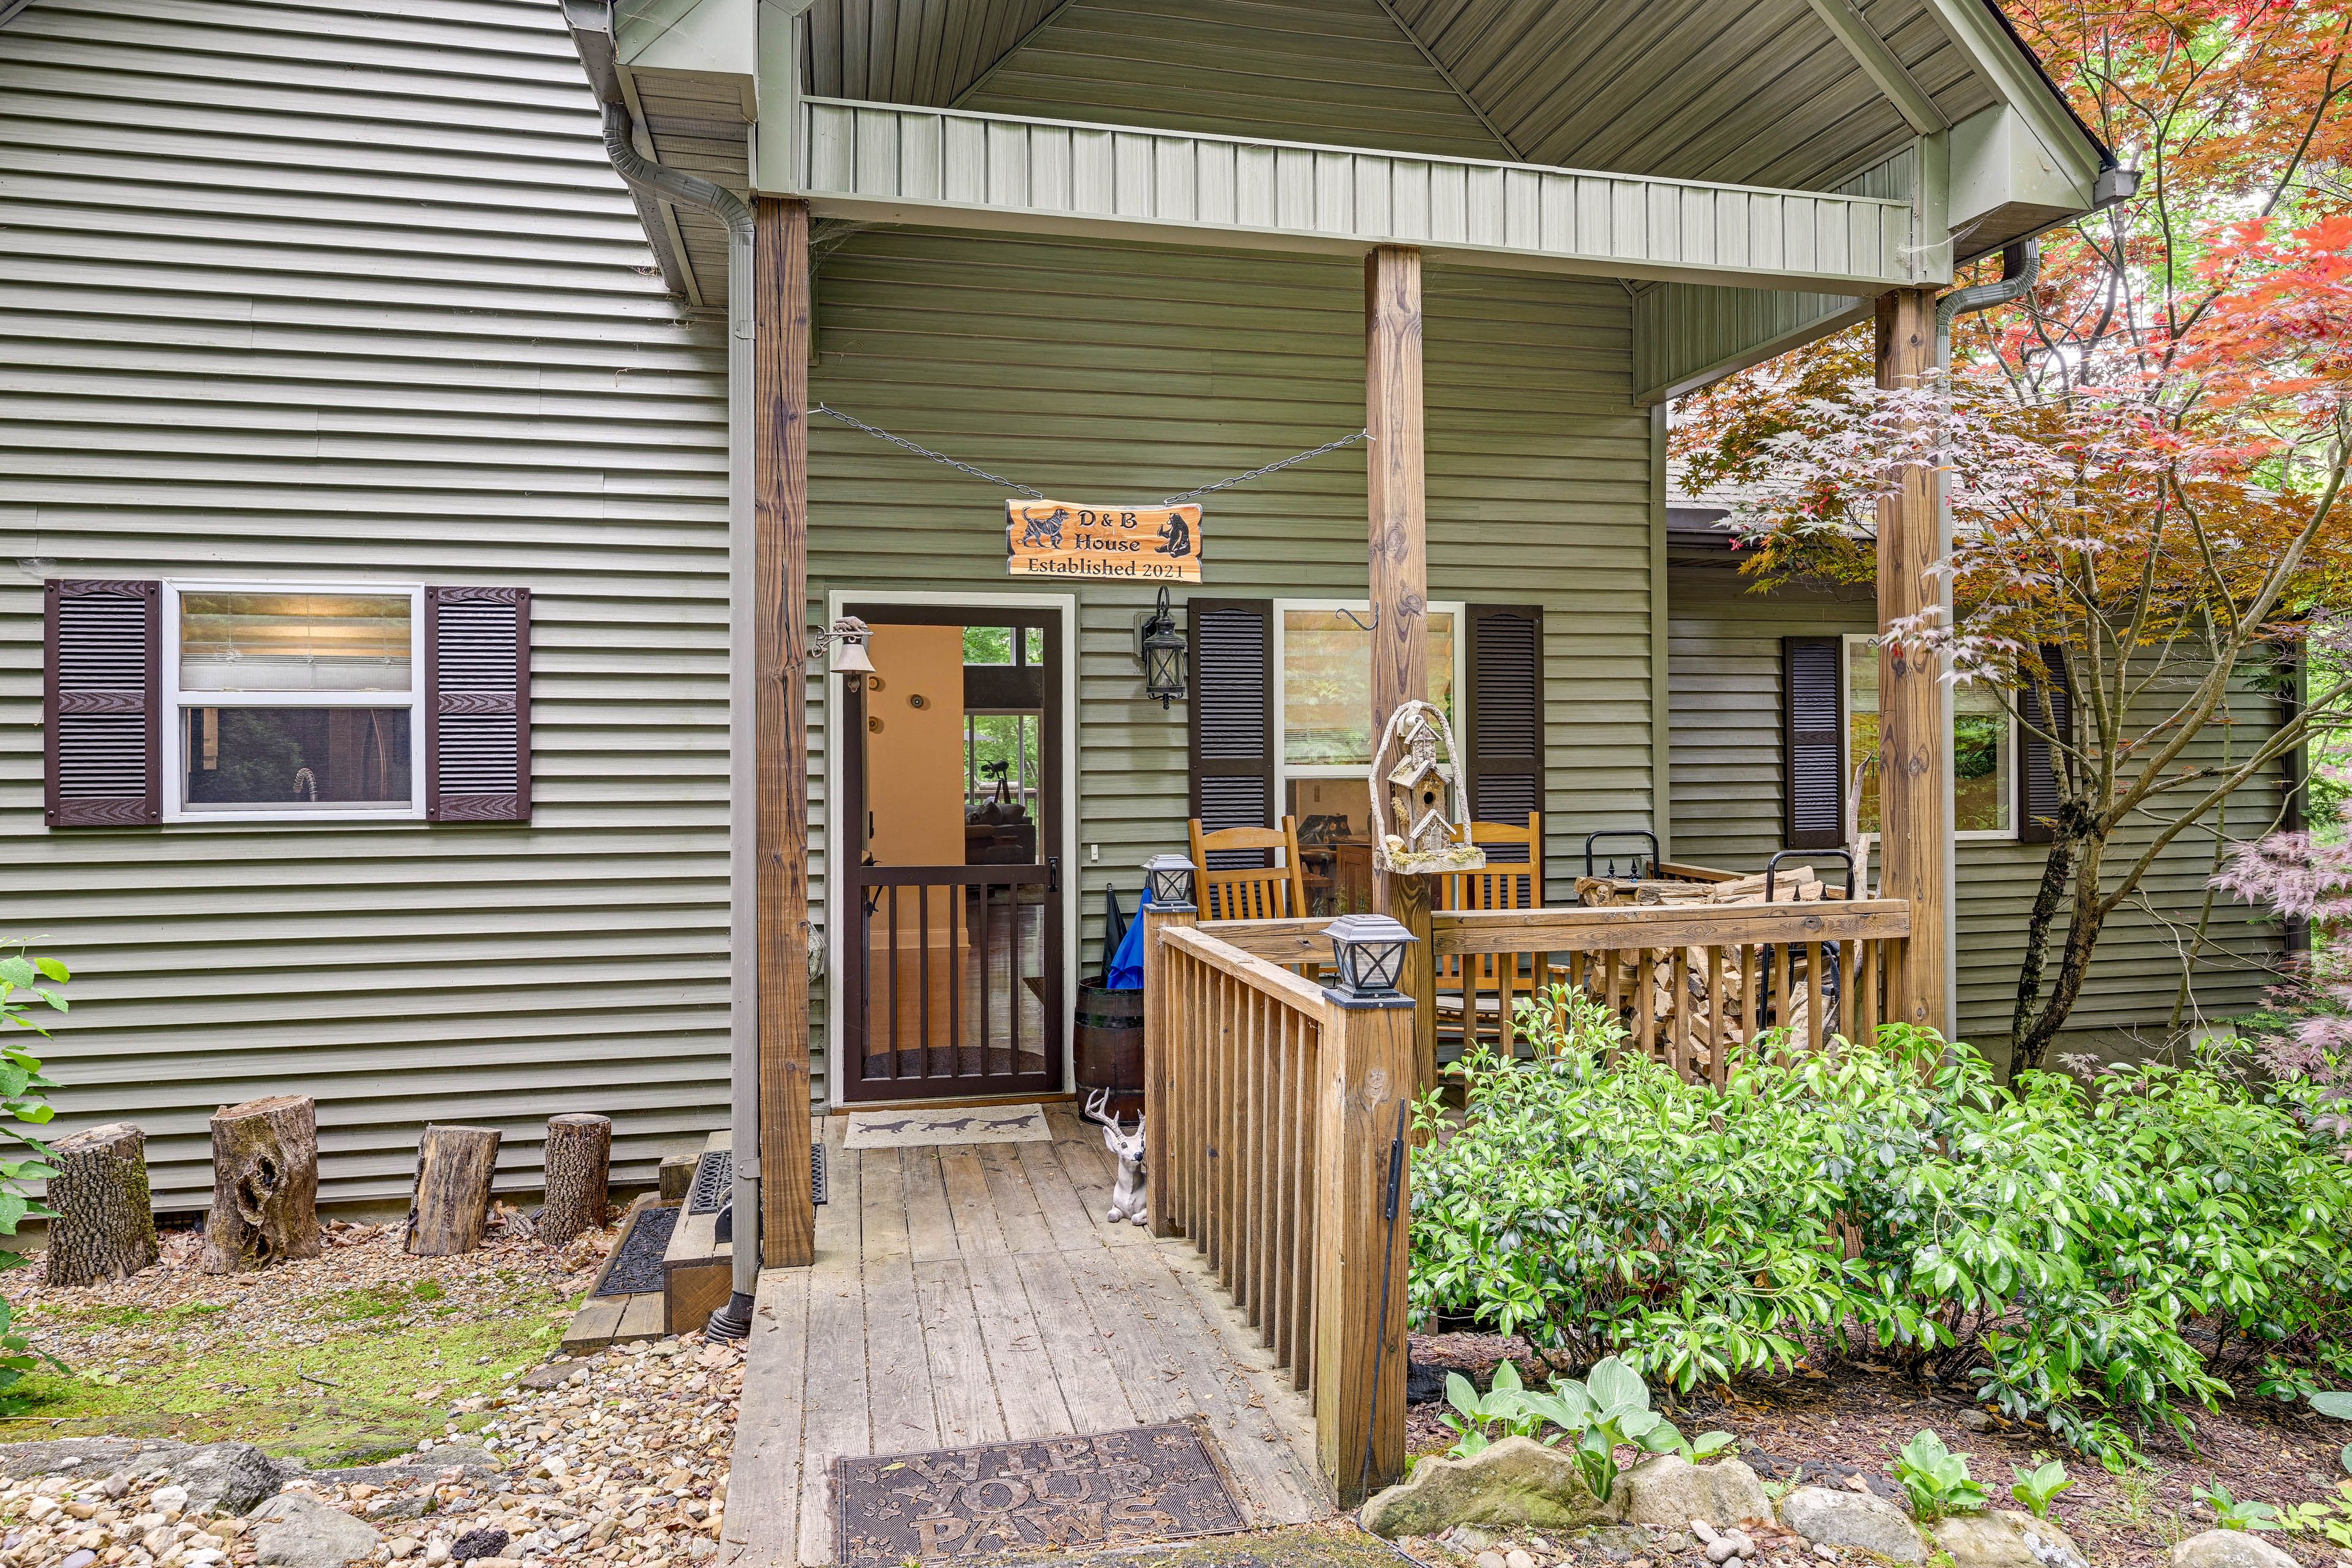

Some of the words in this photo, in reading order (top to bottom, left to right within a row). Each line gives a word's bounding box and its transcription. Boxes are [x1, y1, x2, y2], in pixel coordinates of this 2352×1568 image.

[1077, 510, 1096, 527] D
[1102, 513, 1114, 527] &
[1120, 512, 1138, 529] B
[1074, 533, 1140, 552] House
[1027, 557, 1136, 576] Established
[1142, 564, 1183, 578] 2021
[892, 1431, 1140, 1483] WIPE
[892, 1464, 1168, 1520] YOUR
[909, 1497, 1173, 1559] PAWS
